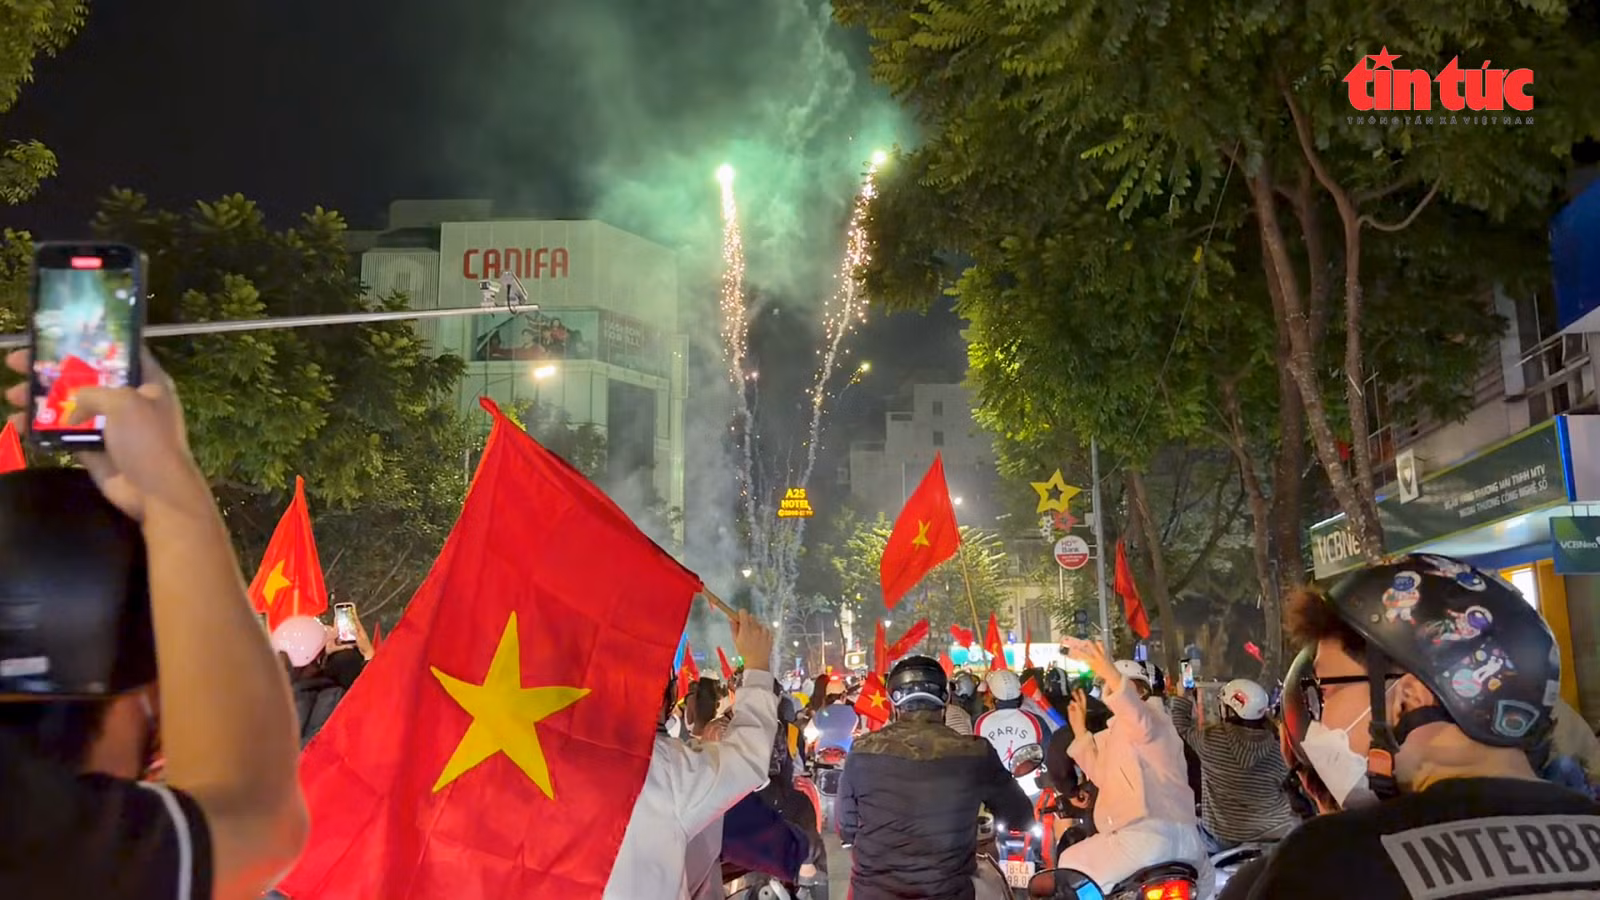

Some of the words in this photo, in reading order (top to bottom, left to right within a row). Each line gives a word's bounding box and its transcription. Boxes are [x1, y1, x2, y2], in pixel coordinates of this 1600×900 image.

[463, 247, 570, 280] CANIFA
[1530, 463, 1546, 479] MTV
[785, 488, 806, 499] A25
[781, 499, 809, 509] HOTEL
[1316, 530, 1361, 565] VCBNe
[988, 726, 1028, 741] PARIS
